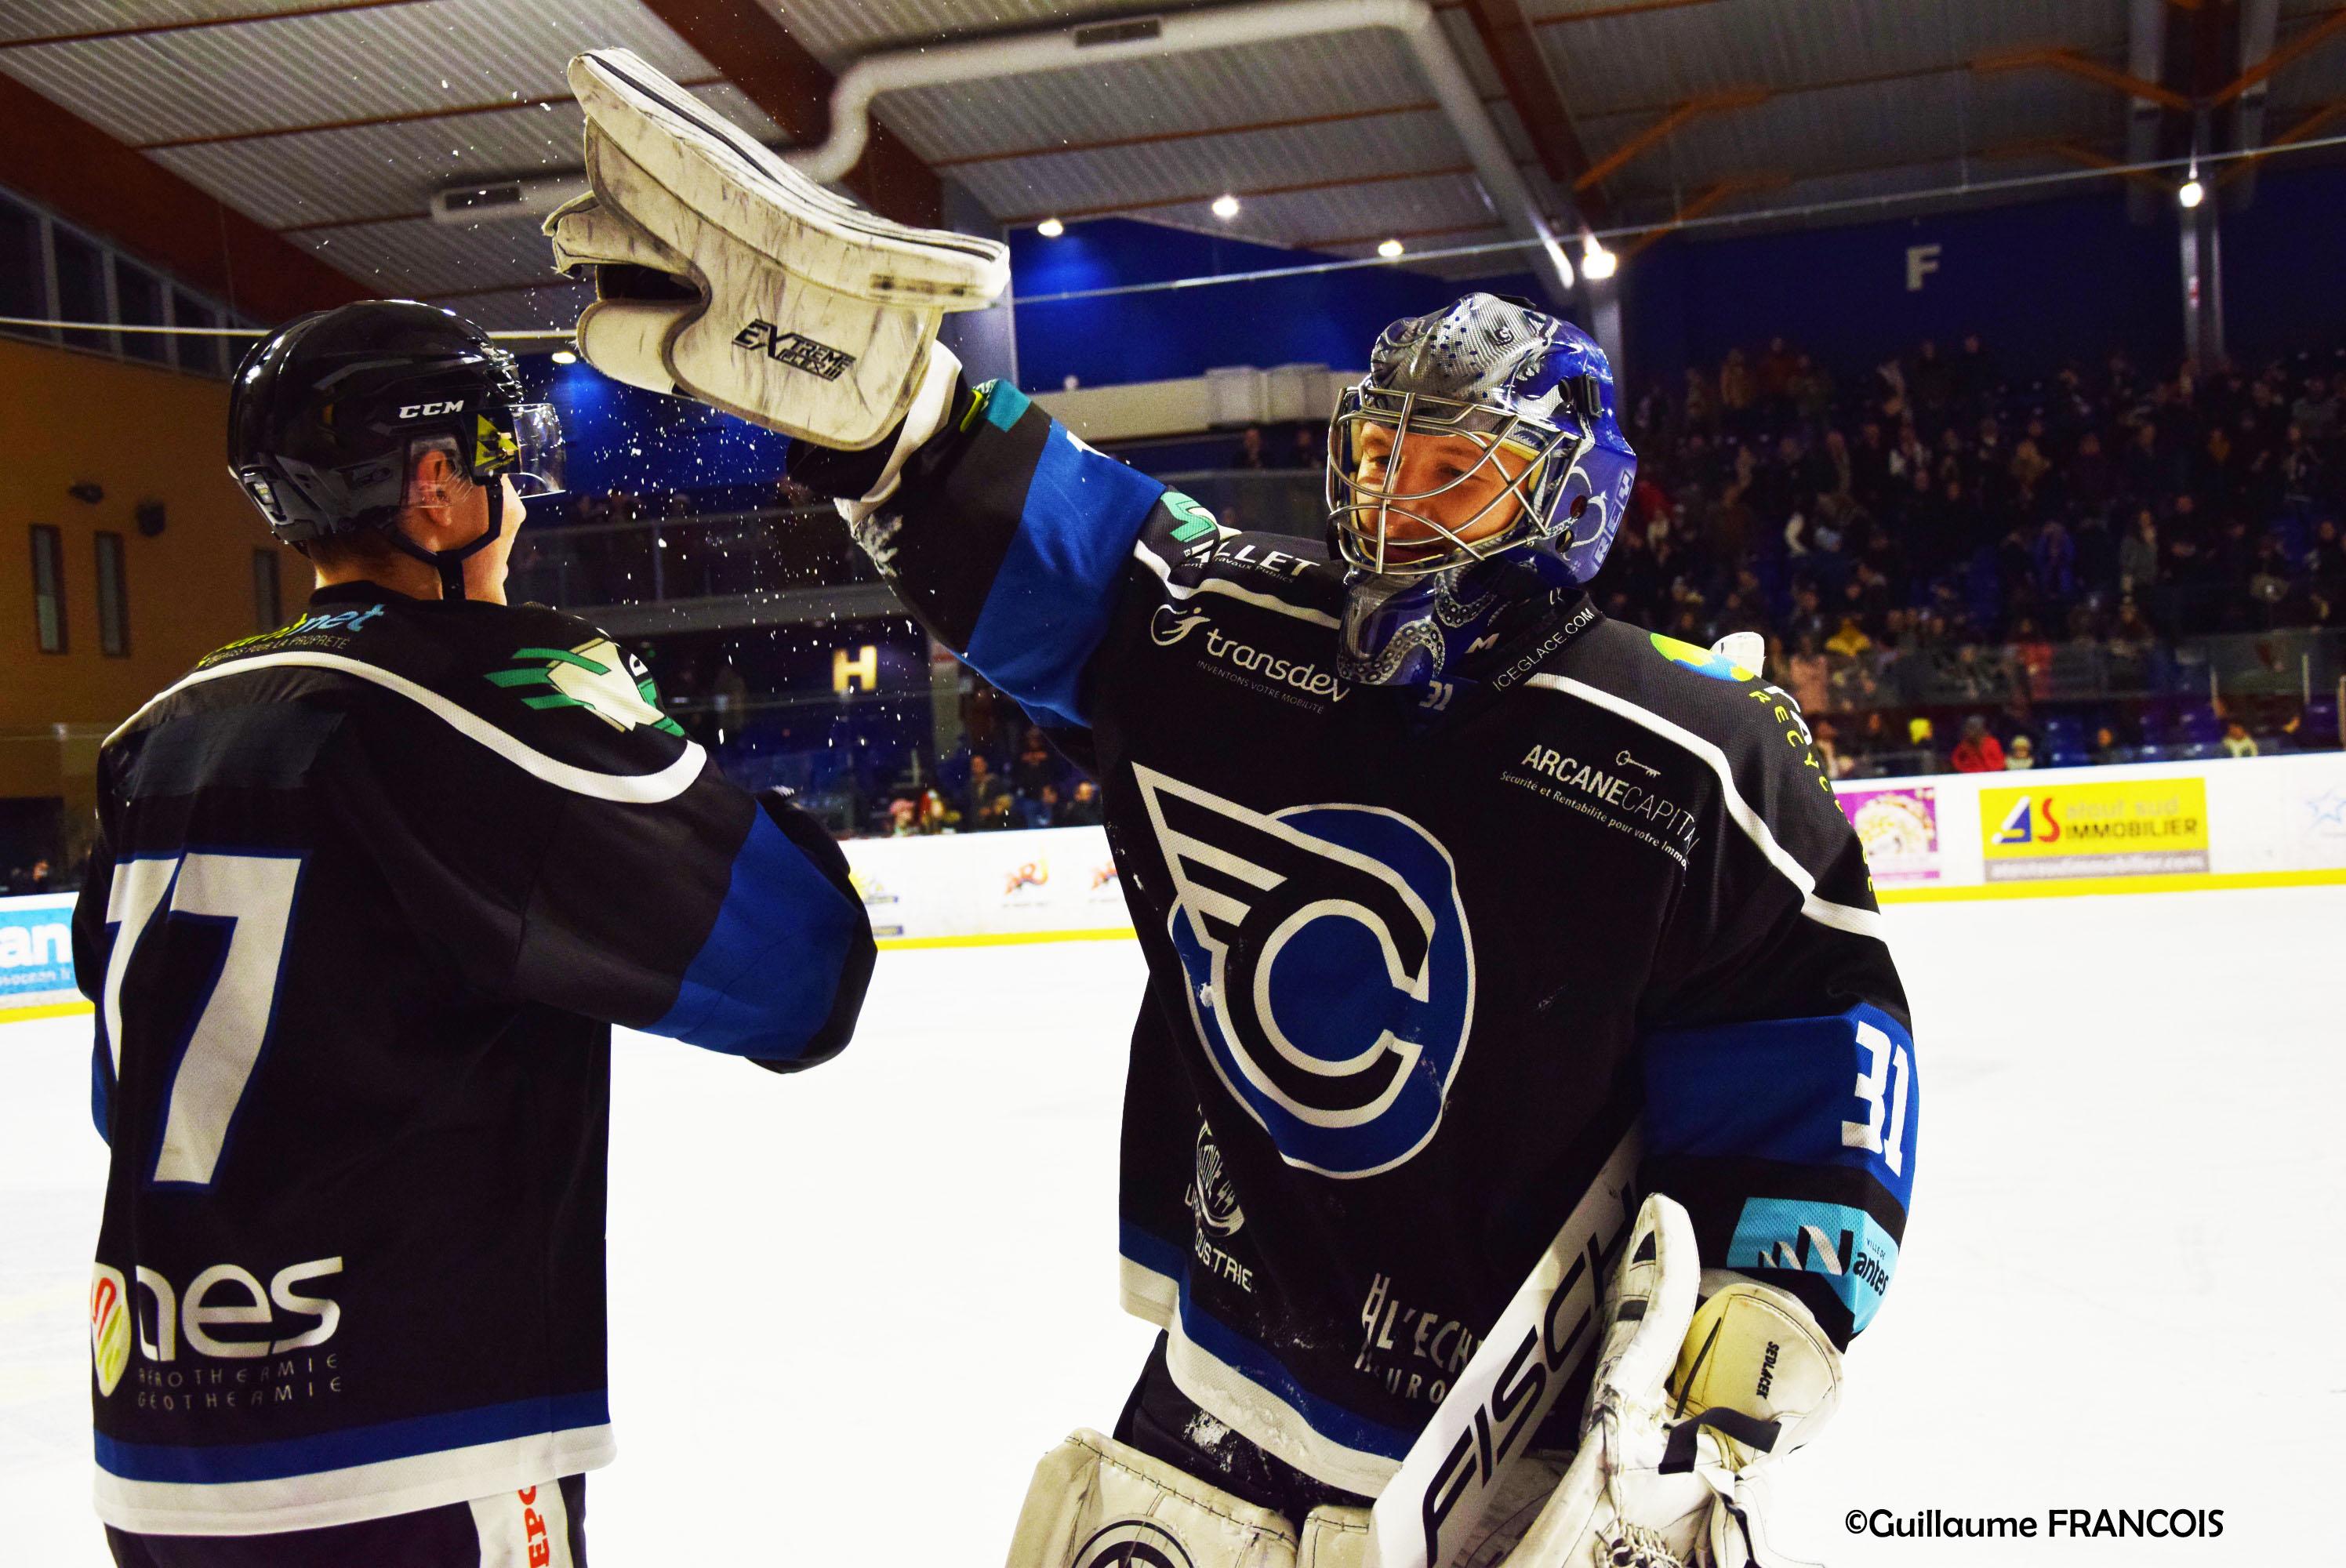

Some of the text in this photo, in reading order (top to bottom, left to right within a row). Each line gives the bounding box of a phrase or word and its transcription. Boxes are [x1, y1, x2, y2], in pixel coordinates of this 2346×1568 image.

[1907, 245, 1941, 290] F
[398, 400, 464, 419] CCM
[833, 645, 877, 691] H
[1197, 660, 1249, 687] INVENTONS
[1251, 682, 1280, 699] VOTRE
[1206, 628, 1350, 702] transdev
[1418, 680, 1454, 711] 31
[1539, 786, 1552, 797] et
[1608, 818, 1633, 837] pour
[1634, 828, 1661, 848] votre
[2134, 794, 2181, 817] sud
[2065, 818, 2199, 841] IMMOBILIER
[1841, 1020, 1909, 1178] 31
